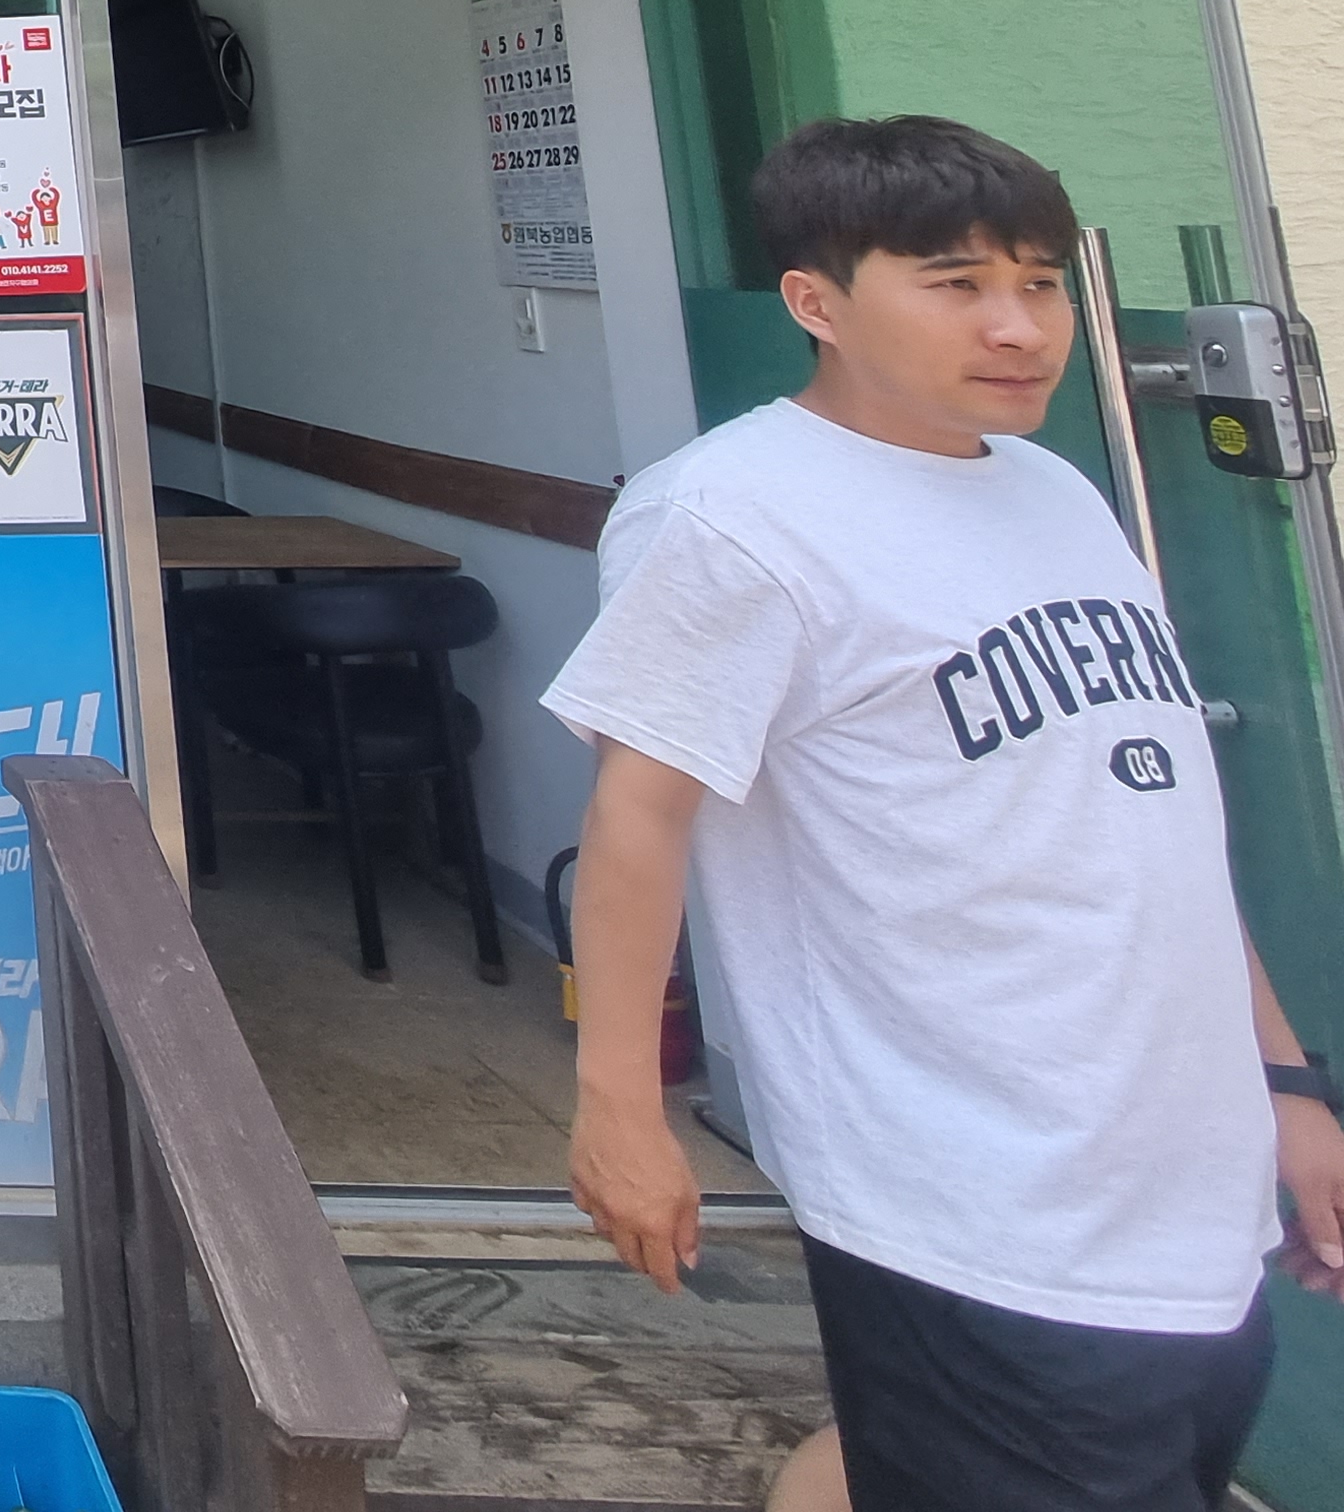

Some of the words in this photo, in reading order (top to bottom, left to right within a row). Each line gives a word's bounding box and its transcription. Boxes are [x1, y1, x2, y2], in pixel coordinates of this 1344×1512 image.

[481, 39, 490, 57] 4
[499, 35, 507, 54] 5
[516, 32, 525, 50] 6
[535, 28, 544, 47] 7
[554, 24, 563, 43] 8
[484, 76, 497, 95] 11
[500, 73, 515, 92] 12
[517, 70, 533, 89] 13
[536, 67, 552, 86] 14
[555, 63, 571, 83] 15
[488, 115, 502, 133] 18
[504, 111, 520, 131] 19
[522, 110, 539, 129] 20
[541, 107, 557, 127] 21
[559, 104, 576, 125] 22
[492, 152, 506, 171] 25
[508, 150, 524, 169] 26
[525, 148, 542, 168] 27
[544, 147, 561, 167] 28
[563, 145, 579, 165] 29
[932, 598, 1208, 762] COVERN
